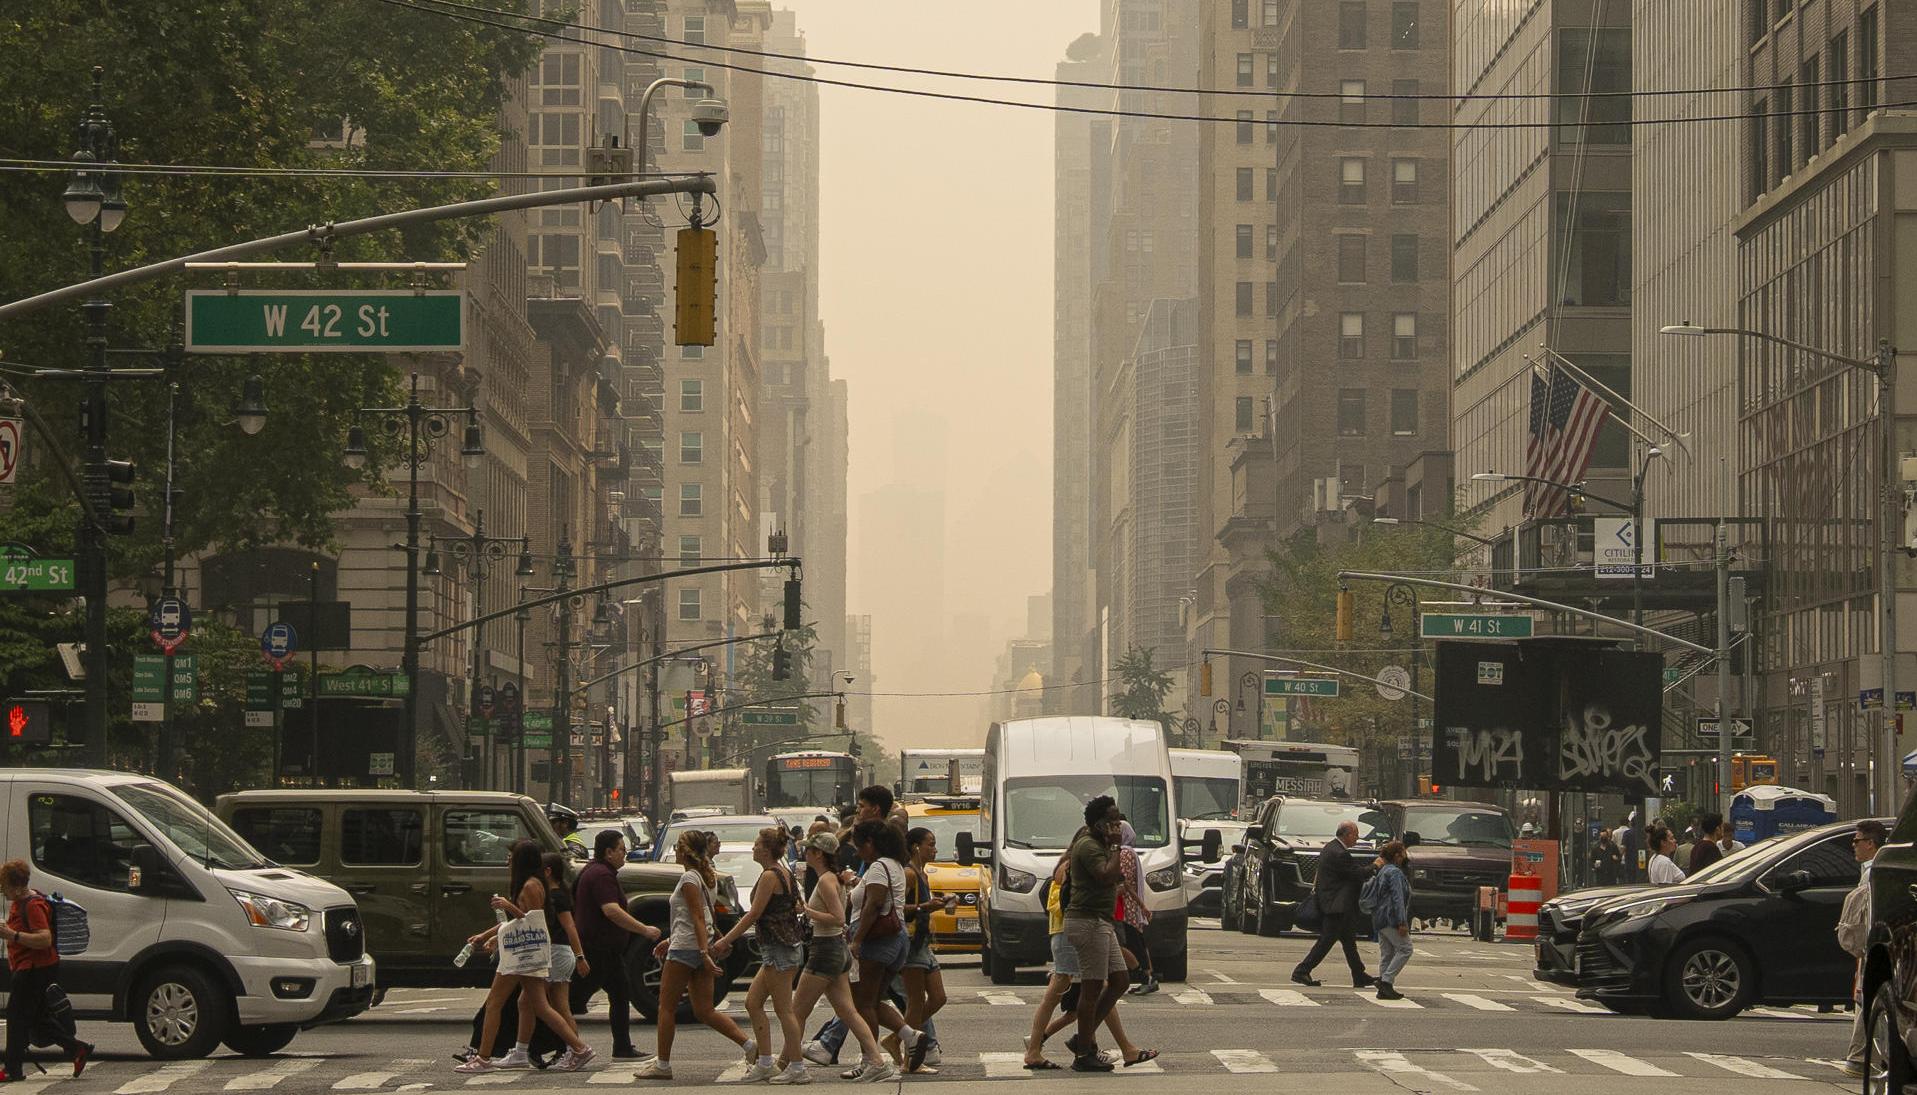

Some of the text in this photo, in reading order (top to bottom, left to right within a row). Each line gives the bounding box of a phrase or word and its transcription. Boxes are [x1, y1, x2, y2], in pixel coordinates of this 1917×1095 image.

[263, 304, 390, 337] W 42 St
[4, 565, 69, 585] 42nd St
[1453, 619, 1501, 634] W 41 St
[174, 658, 192, 668] QM1
[174, 673, 192, 684] QM5
[326, 679, 356, 691] West
[1284, 682, 1319, 693] W 40 St
[174, 689, 192, 699] QM6
[1276, 779, 1322, 792] MESSIAH
[503, 932, 548, 946] GRAND SLAM
